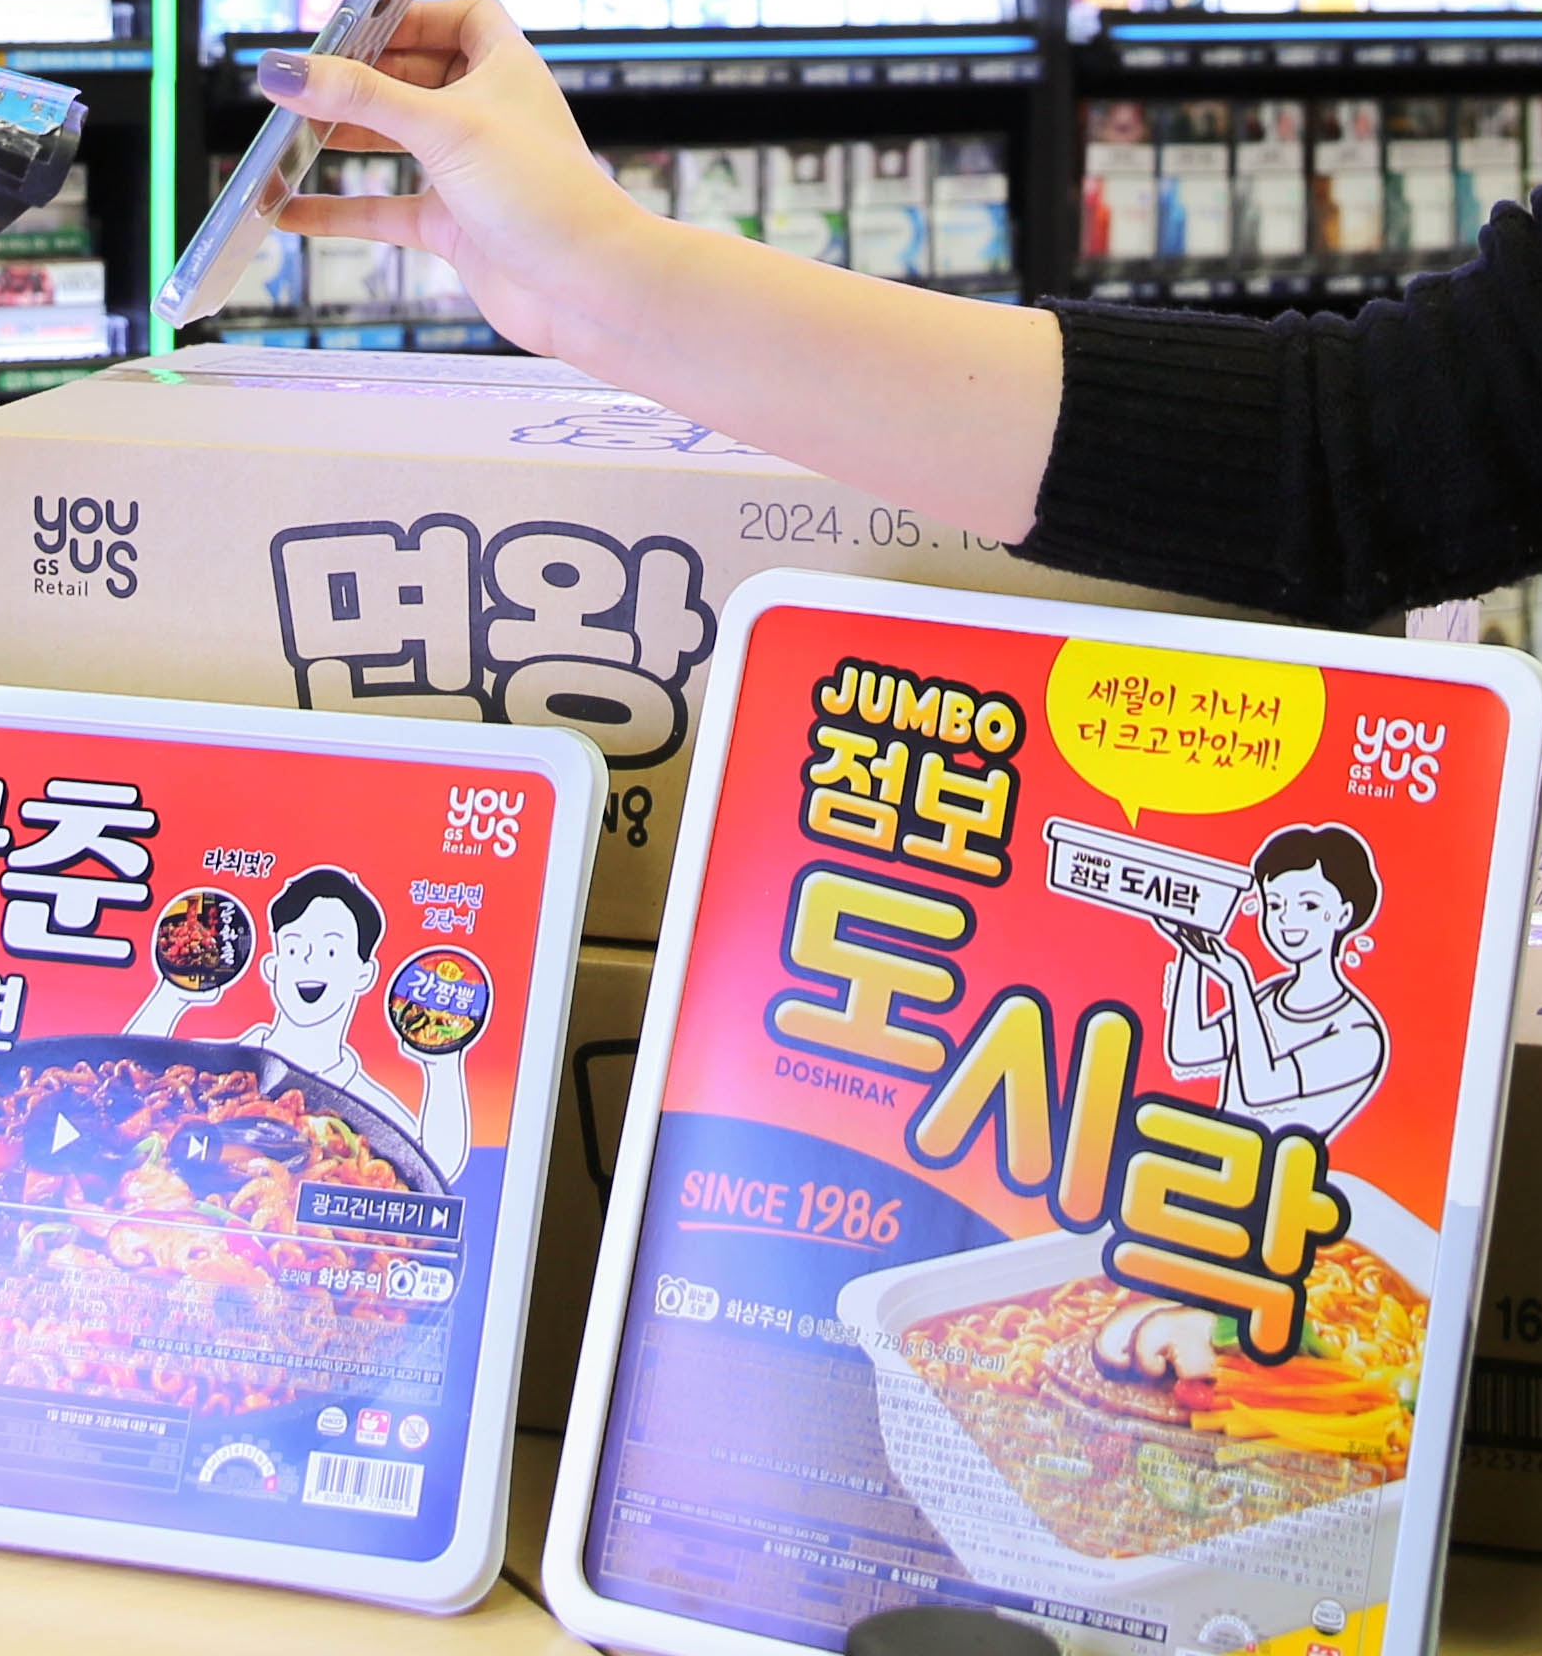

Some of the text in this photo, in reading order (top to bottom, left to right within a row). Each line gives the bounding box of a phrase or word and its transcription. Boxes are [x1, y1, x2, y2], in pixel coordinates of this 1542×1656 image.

[33, 494, 139, 556] you
[740, 502, 1000, 551] 2024.05.
[33, 557, 59, 576] GS
[33, 577, 89, 598] Retail
[69, 538, 139, 599] us
[820, 665, 1016, 753] JUMBO
[1088, 676, 1283, 726] 세월이 지나서
[1077, 723, 1283, 772] 더 크고 맛있게!
[1355, 715, 1445, 765] you
[1347, 781, 1394, 800] Retail
[1349, 765, 1372, 780] GS
[1381, 749, 1440, 803] us
[447, 786, 525, 828] you
[807, 725, 1010, 878] 점보
[442, 840, 483, 856] Retail
[444, 827, 464, 841] GS
[470, 814, 521, 858] us
[204, 847, 276, 876] 라최몇?
[1072, 852, 1112, 867] JUMBO
[410, 879, 483, 910] 점보라면
[1069, 863, 1200, 915] 점보 도시락
[407, 968, 477, 1012] 간짬뽕
[774, 1054, 897, 1109] DOSHIRAK
[772, 869, 1341, 1358] 도시락
[312, 1193, 424, 1227] 광고건너뛰기
[678, 1169, 903, 1244] SINCE 1986
[279, 1267, 311, 1285] 조리예
[317, 1267, 383, 1294] 화상주의
[725, 1299, 793, 1334] 화상주의
[817, 1317, 861, 1347] 내용량
[873, 1332, 902, 1352] 729
[970, 1350, 1007, 1373] kcal)
[774, 1542, 800, 1559] 내용량
[802, 1547, 819, 1563] 729
[857, 1559, 876, 1575] kcal
